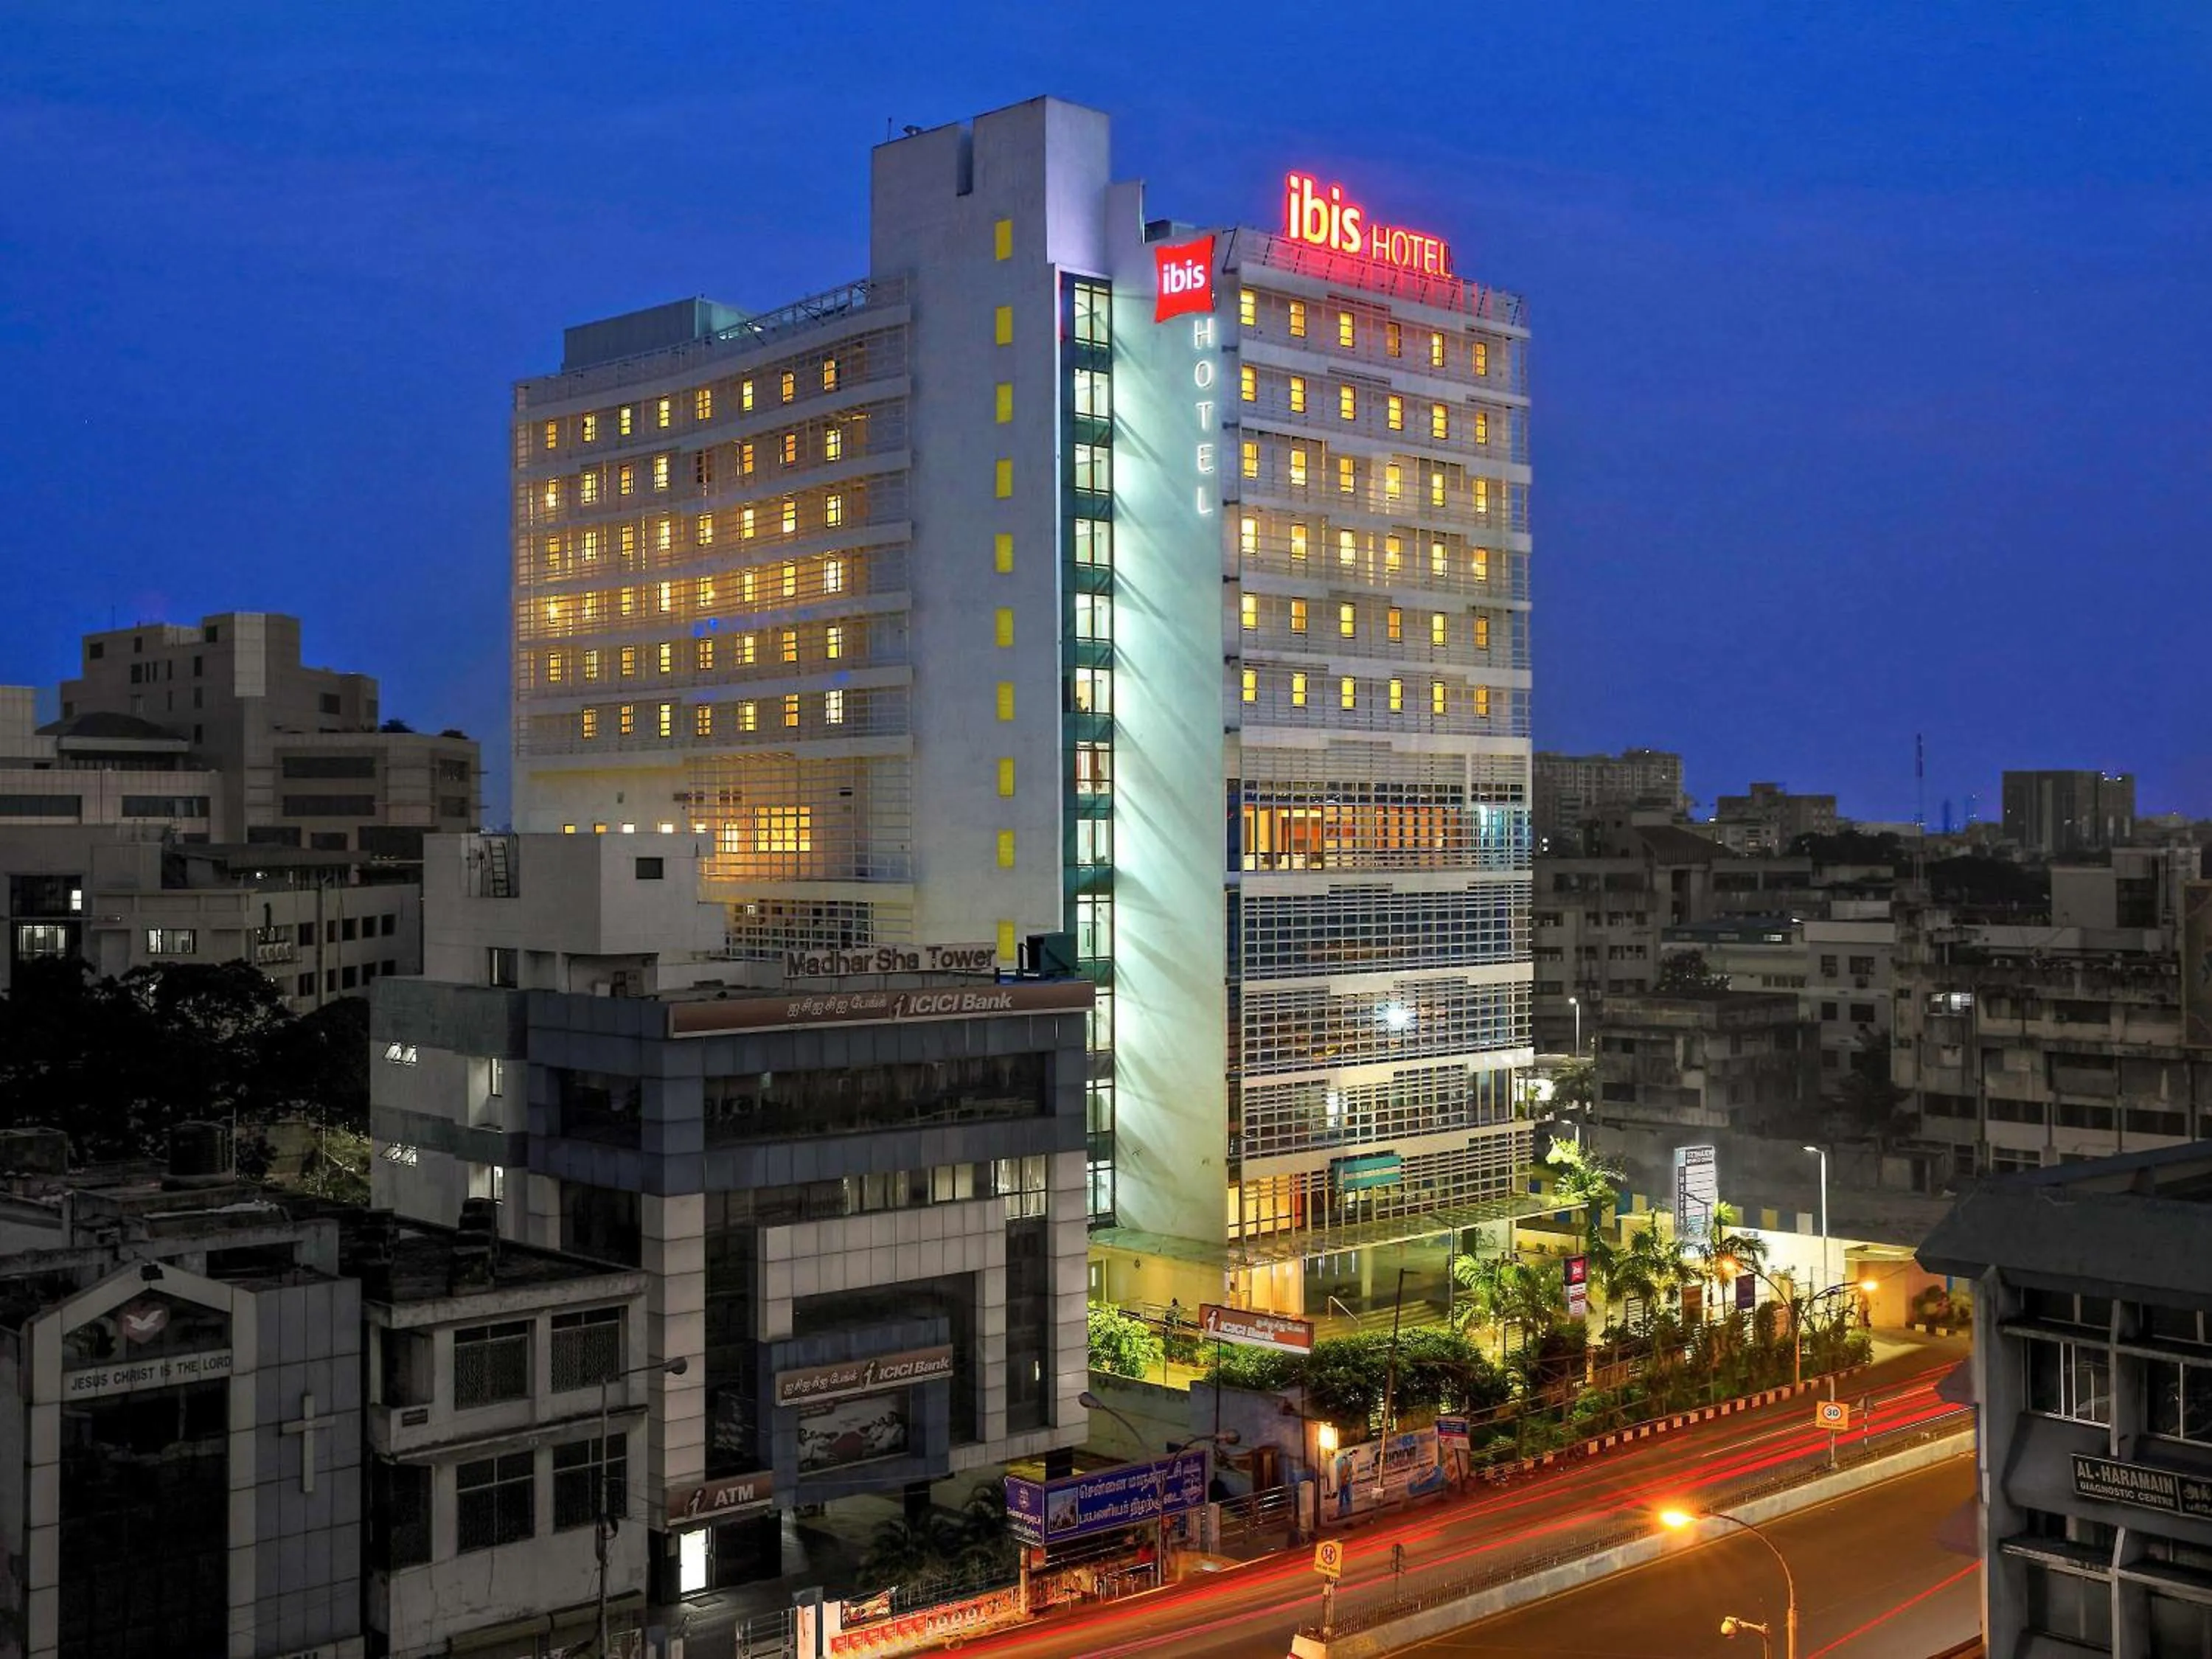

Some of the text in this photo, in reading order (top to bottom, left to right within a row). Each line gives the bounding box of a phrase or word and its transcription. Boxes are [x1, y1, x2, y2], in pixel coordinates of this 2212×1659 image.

[1289, 174, 1453, 278] ibis HOTEL
[1162, 259, 1206, 295] ibis
[1193, 316, 1215, 515] HOTEL
[786, 946, 996, 976] Madhar Sha Tower
[908, 995, 959, 1015] ICICI
[962, 991, 1013, 1011] Bank
[72, 1355, 232, 1391] JESUS CHRIST IS THE LORD
[878, 1363, 914, 1380] ICICI
[914, 1356, 950, 1374] Bank
[714, 1484, 755, 1508] ATM
[2079, 1481, 2135, 1500] DIAGNOSTIC
[2138, 1492, 2175, 1509] CENTRE
